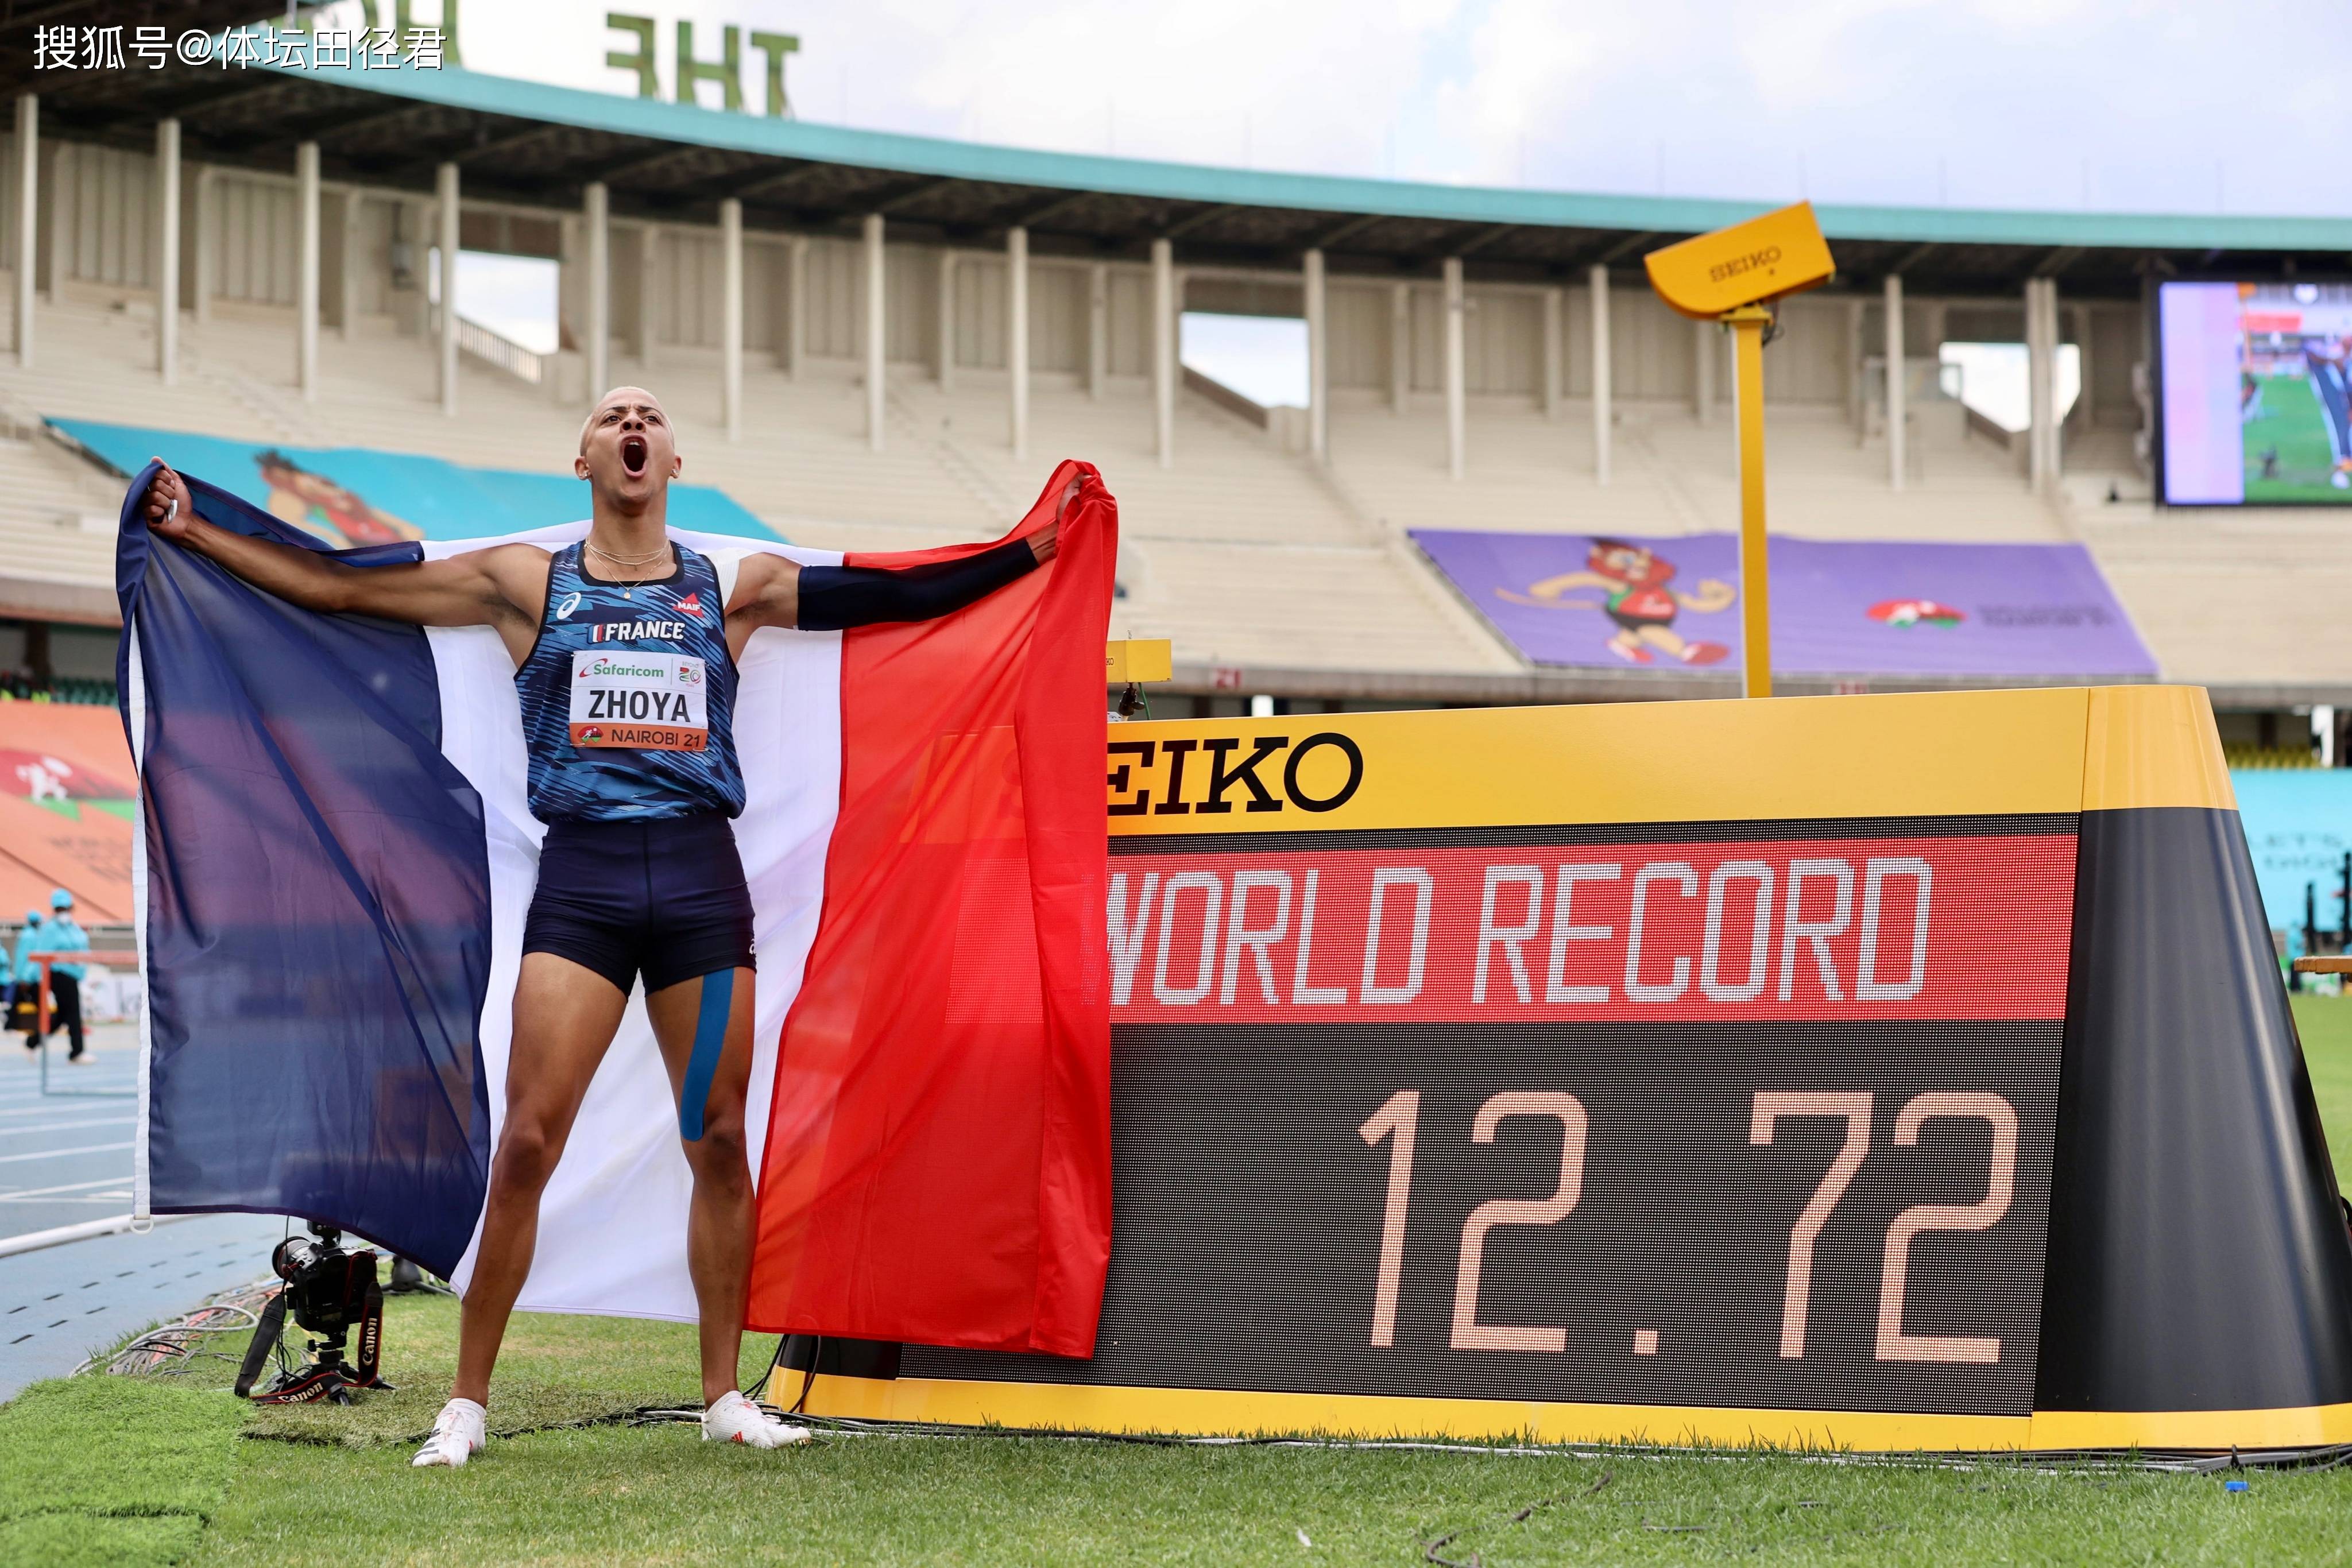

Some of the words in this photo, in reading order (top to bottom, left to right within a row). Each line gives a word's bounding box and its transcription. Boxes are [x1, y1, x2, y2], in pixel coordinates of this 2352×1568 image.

[1709, 245, 1782, 282] SEIKO
[678, 602, 701, 611] MAIF
[605, 621, 686, 641] FRANCE
[593, 664, 664, 677] Safaricom
[588, 690, 691, 722] ZHOYA
[612, 729, 679, 745] NAIROBI
[684, 734, 701, 748] 21
[1108, 732, 1364, 816] EIKO
[1107, 866, 1434, 1005] WORLD
[1472, 857, 1933, 1004] RECORD
[1358, 1090, 2019, 1363] 12.72
[362, 1317, 377, 1366] Canon
[278, 1381, 323, 1403] Canon
